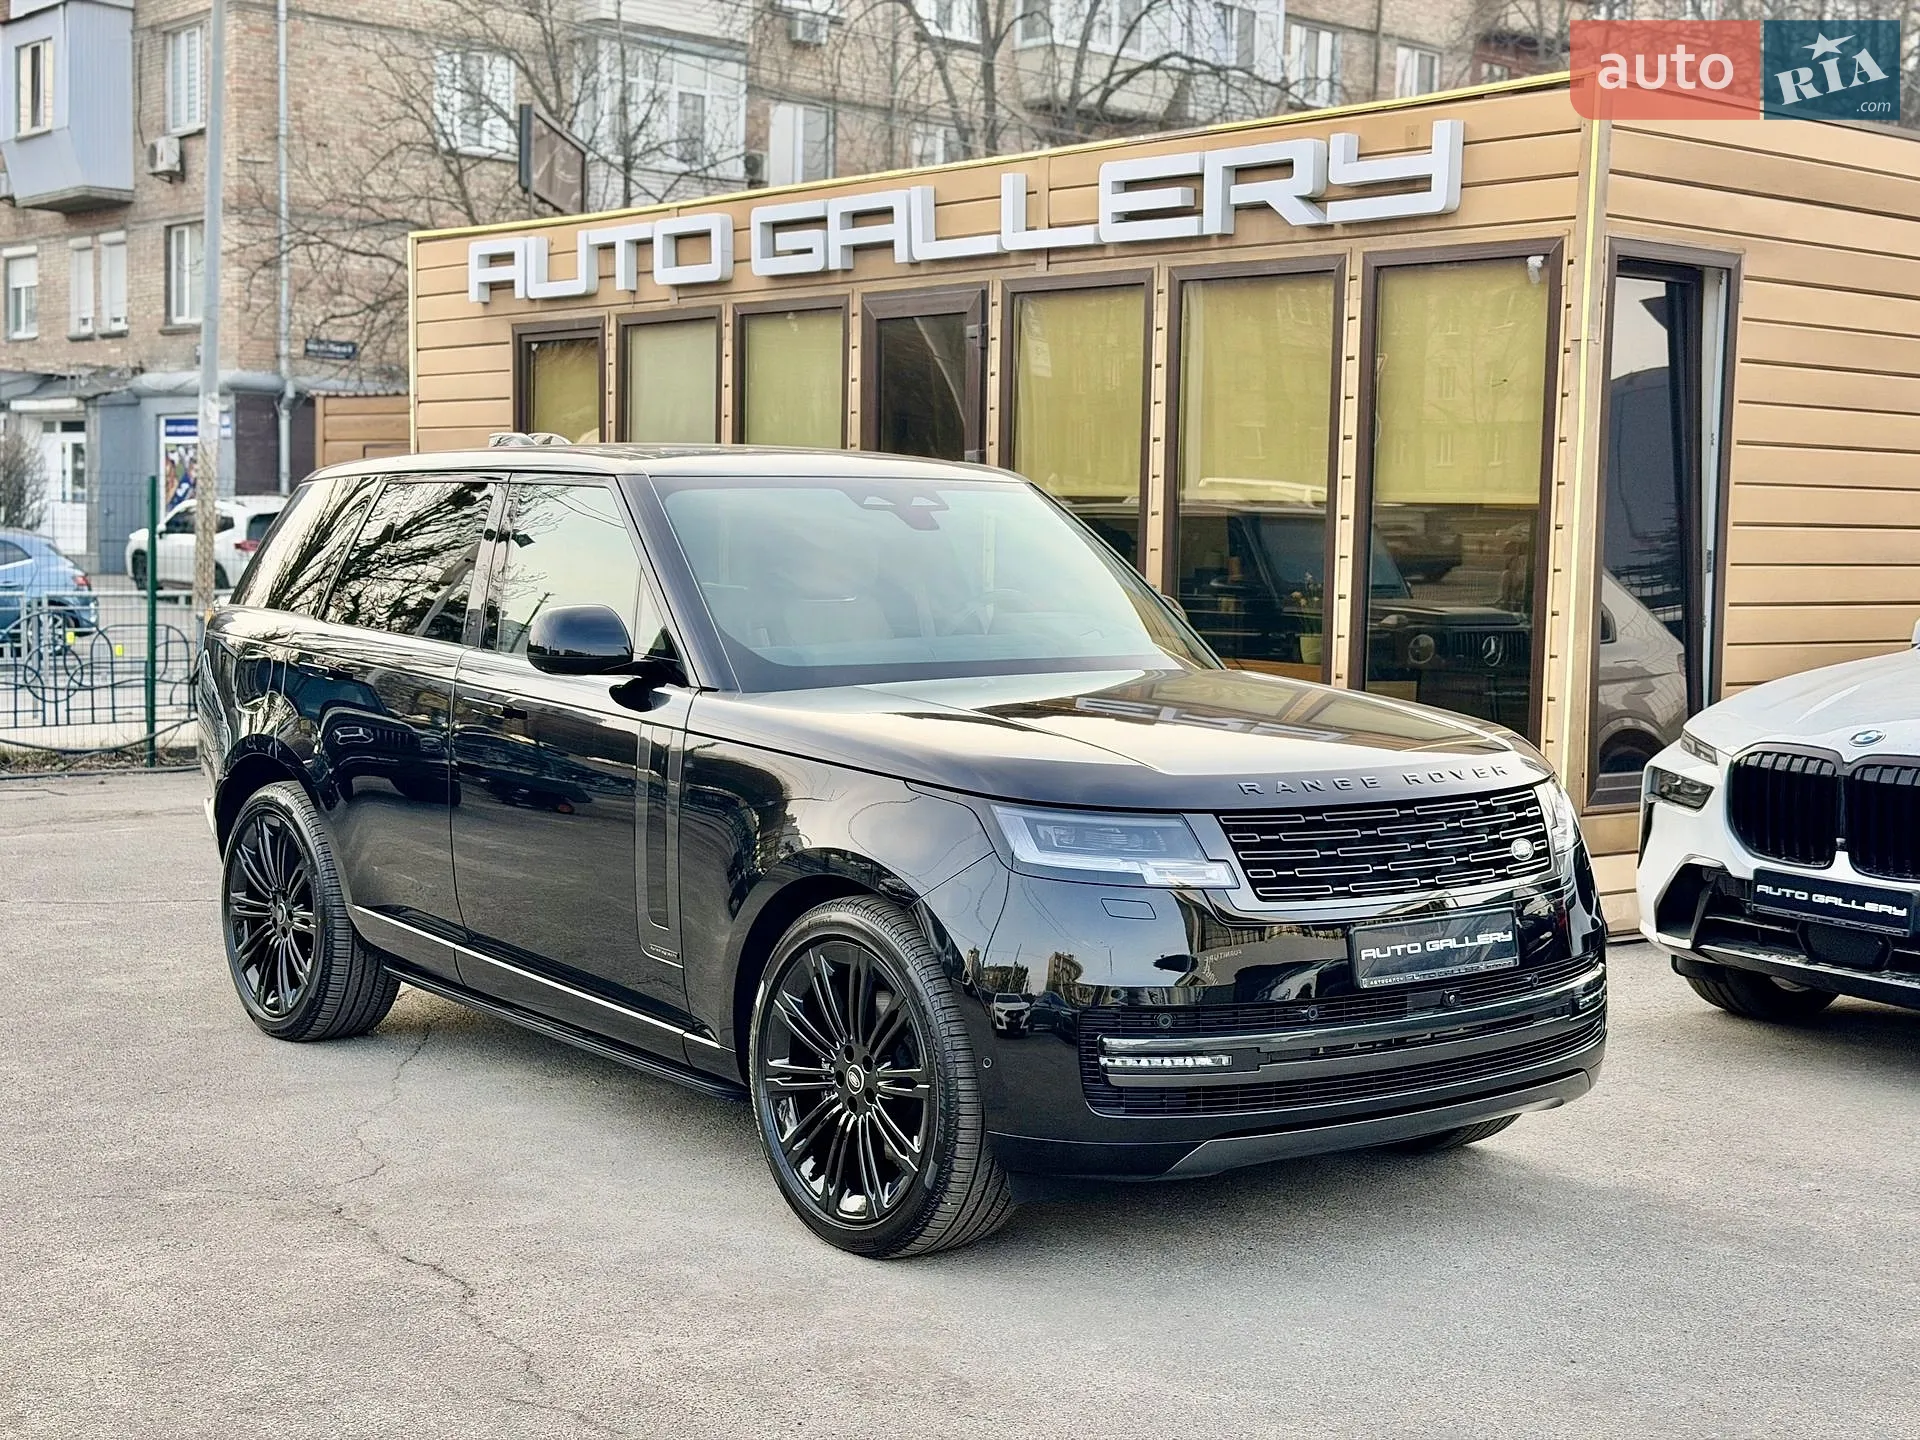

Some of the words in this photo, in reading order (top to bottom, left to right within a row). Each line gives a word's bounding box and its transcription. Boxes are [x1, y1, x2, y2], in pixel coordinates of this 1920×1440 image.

[468, 212, 733, 303] AUTO
[751, 119, 1464, 276] GALLERY
[1238, 775, 1381, 795] RANGE
[1402, 766, 1509, 786] ROVER
[1756, 884, 1808, 901] AUTO
[1811, 894, 1907, 917] GALLERY
[1361, 942, 1421, 961] AUTO
[1425, 930, 1512, 952] GALLERY
